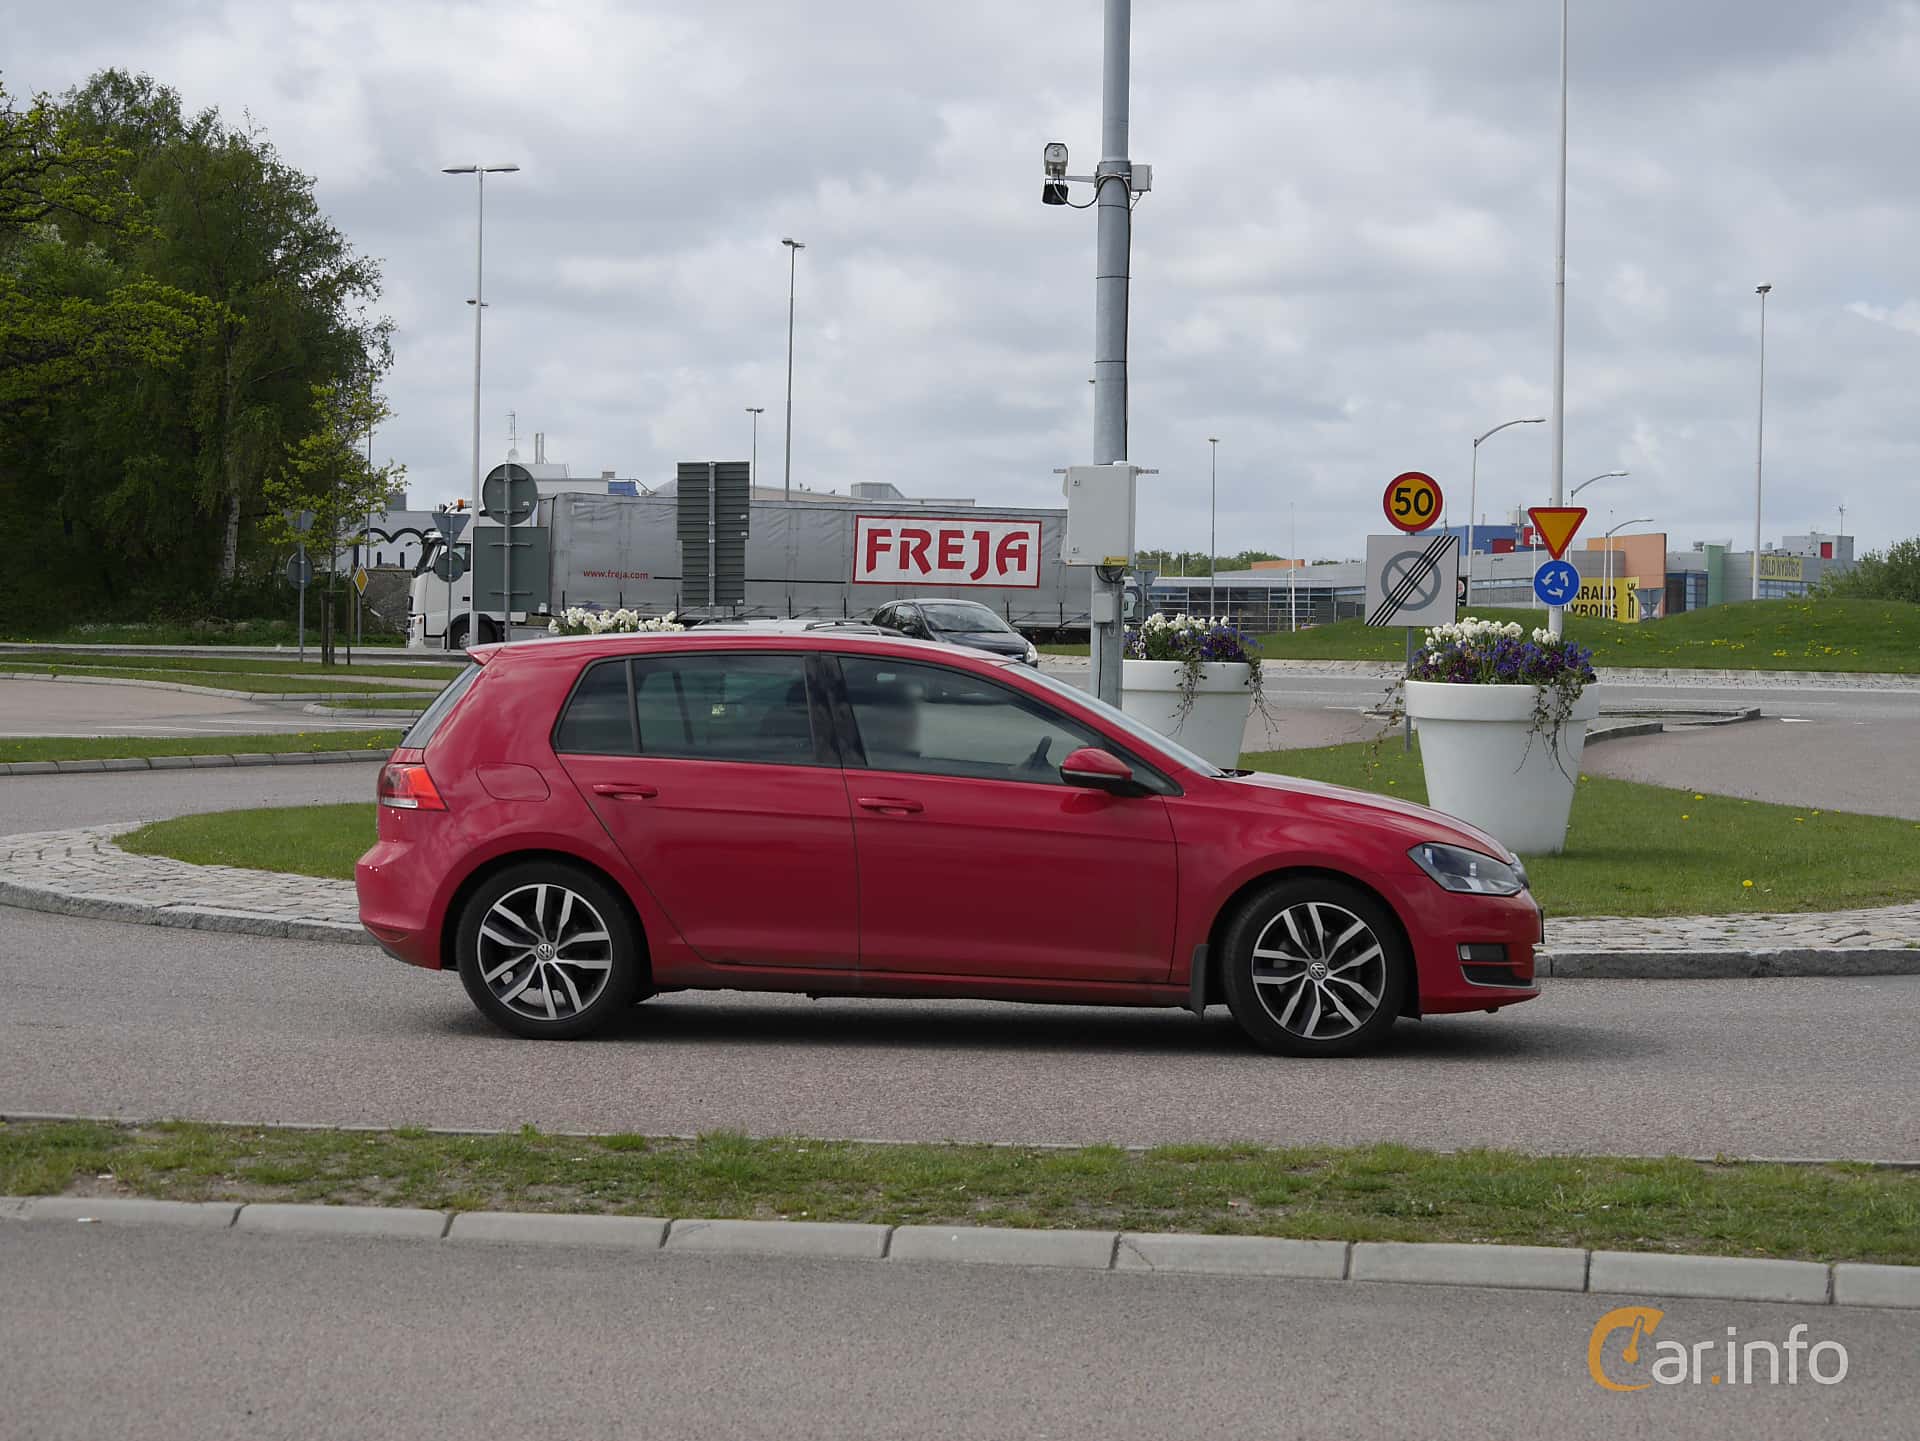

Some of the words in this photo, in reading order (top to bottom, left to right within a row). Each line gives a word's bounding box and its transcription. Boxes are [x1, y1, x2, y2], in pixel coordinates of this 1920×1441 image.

[1394, 487, 1433, 516] 50
[866, 528, 1030, 581] FREJA
[583, 569, 648, 580] www.freja.com
